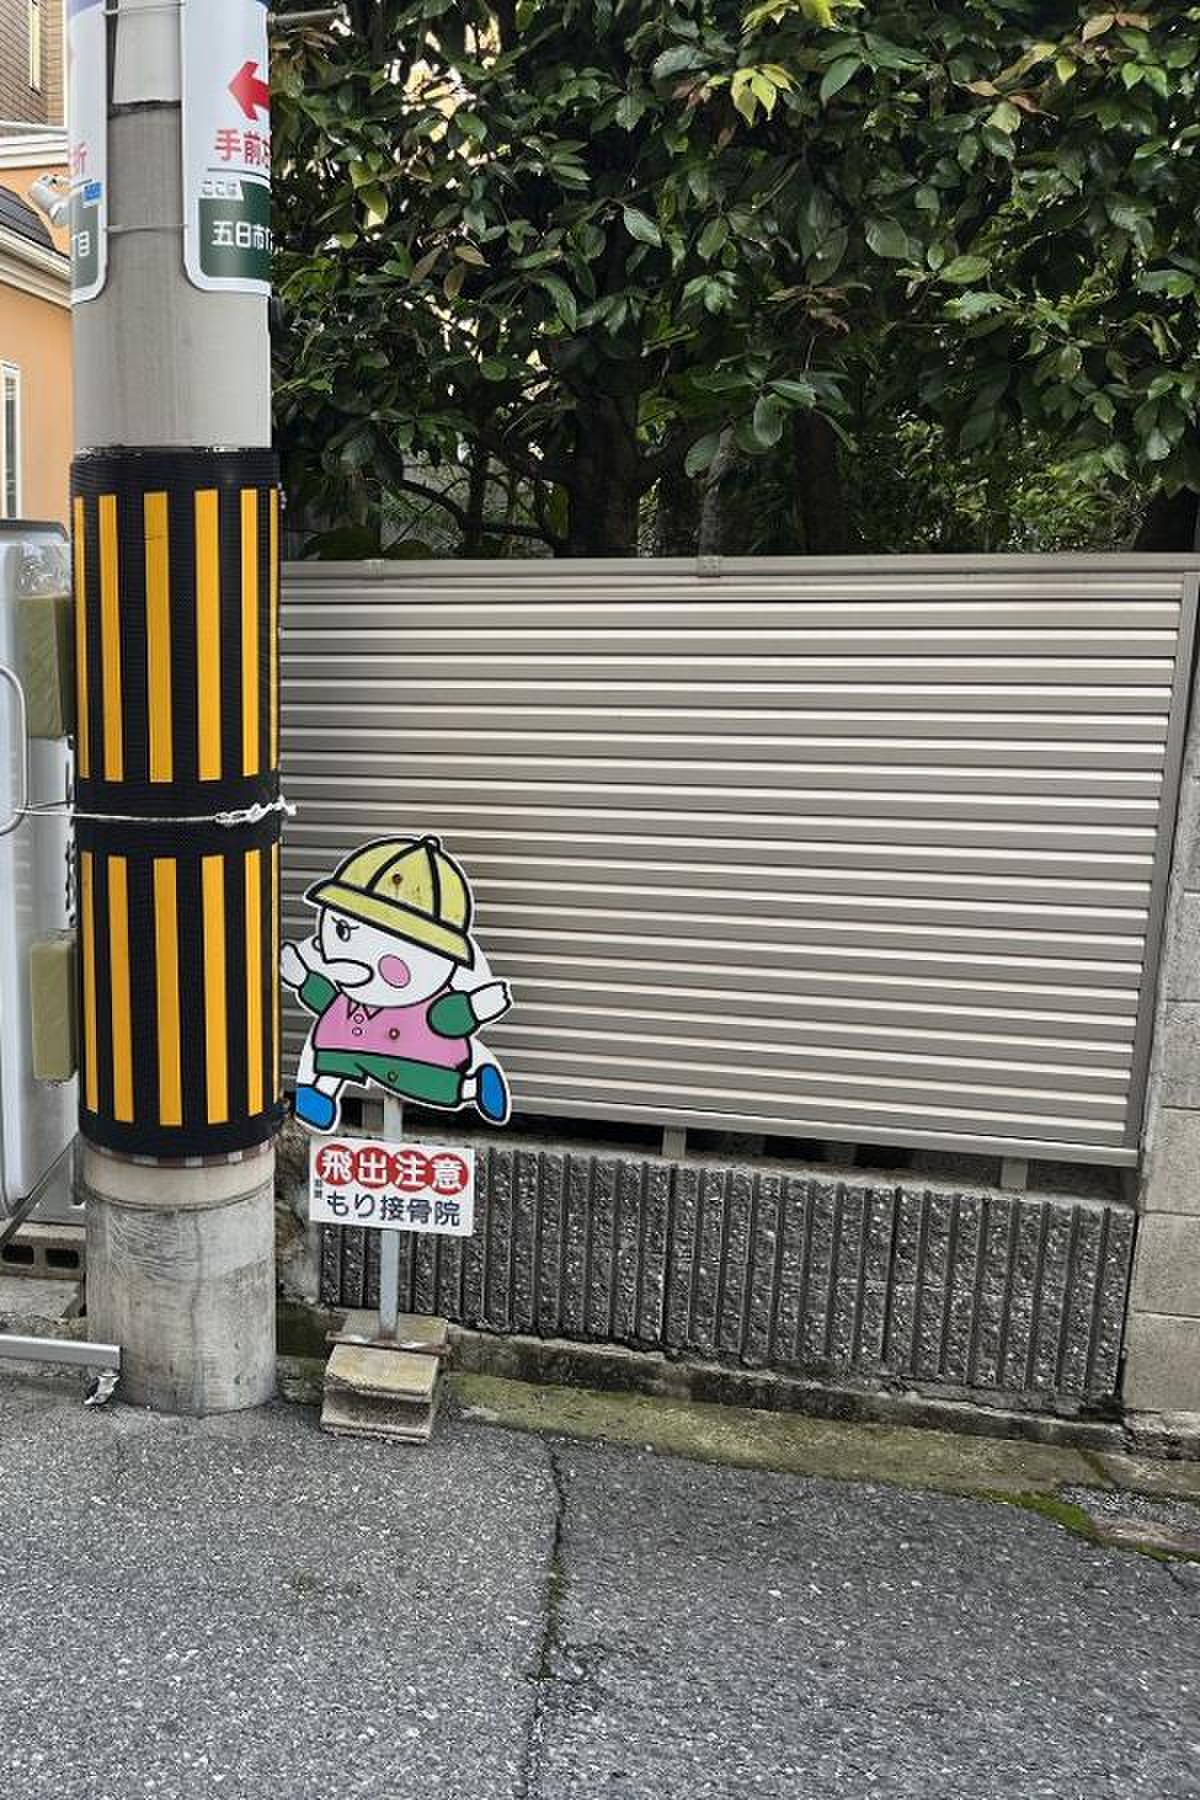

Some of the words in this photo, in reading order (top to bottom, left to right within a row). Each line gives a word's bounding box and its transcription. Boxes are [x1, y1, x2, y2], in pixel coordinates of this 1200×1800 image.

[319, 1147, 466, 1191] 飛出注意
[326, 1190, 461, 1227] もり接骨院
